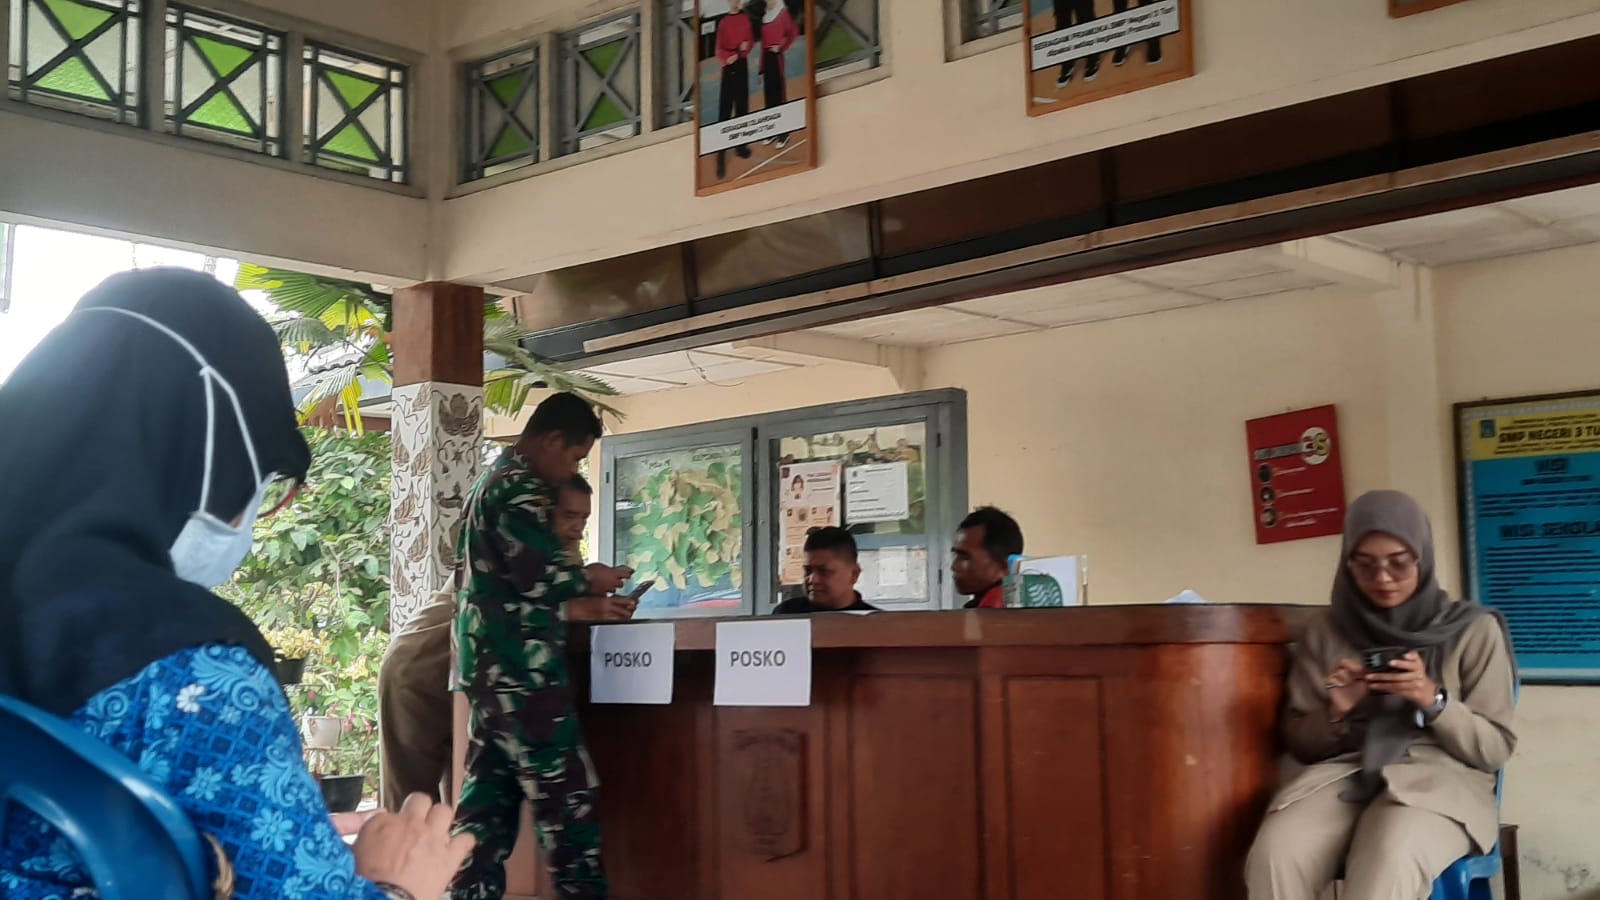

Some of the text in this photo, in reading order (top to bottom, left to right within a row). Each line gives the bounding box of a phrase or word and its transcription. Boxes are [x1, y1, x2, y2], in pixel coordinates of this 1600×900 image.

[1499, 431, 1526, 443] SMP
[1528, 427, 1572, 441] NEGERI
[1574, 426, 1583, 438] 3
[604, 651, 653, 668] POSKO
[730, 650, 786, 668] POSKO
